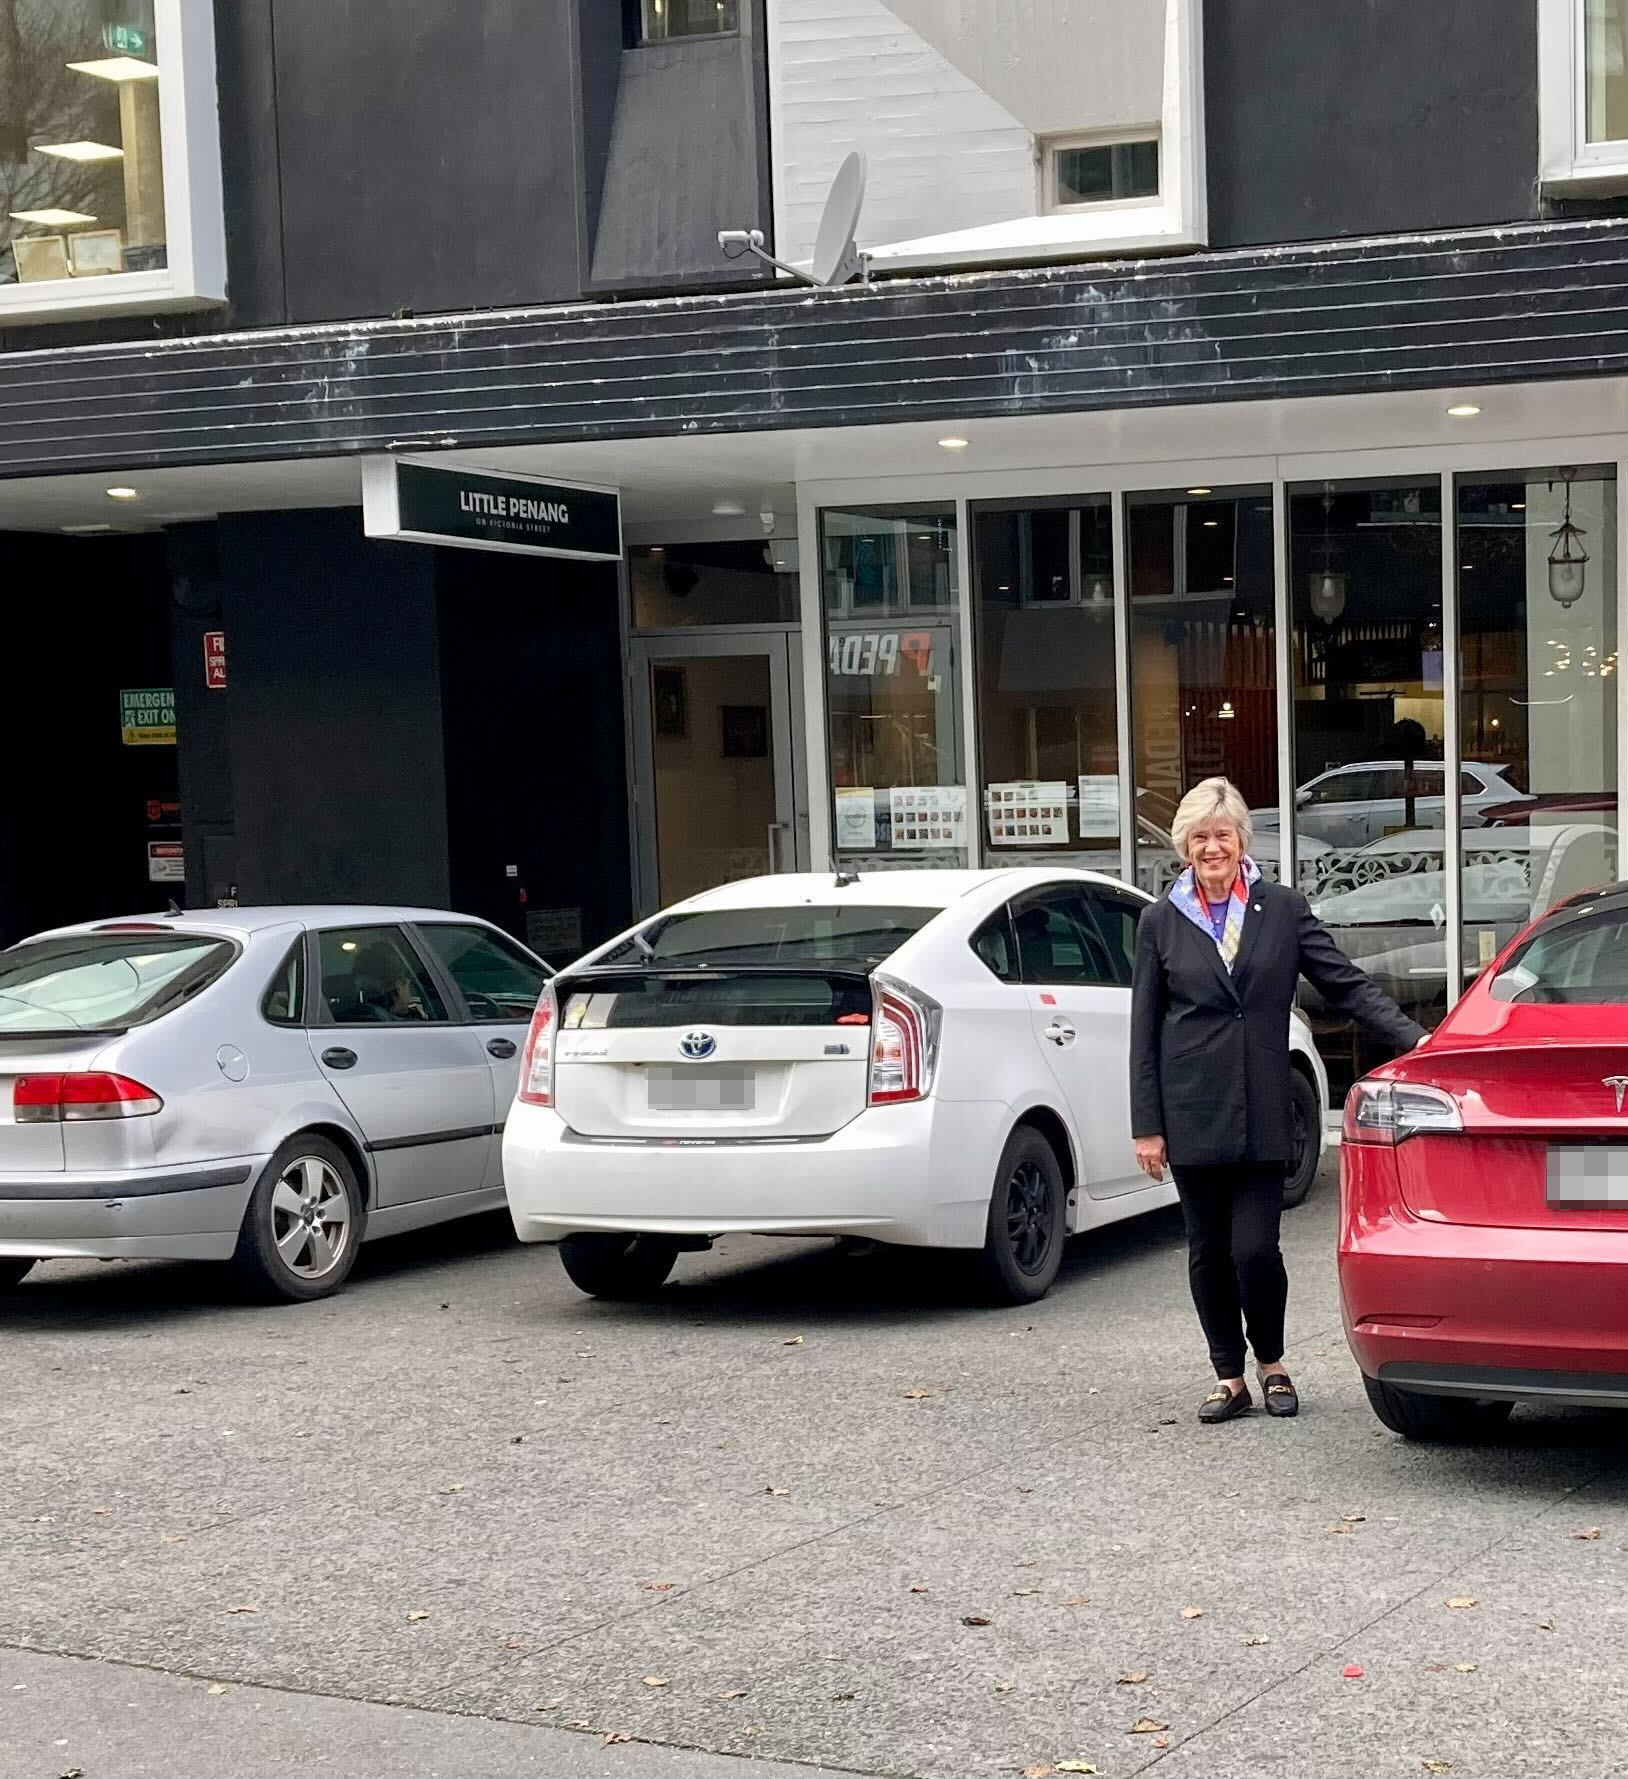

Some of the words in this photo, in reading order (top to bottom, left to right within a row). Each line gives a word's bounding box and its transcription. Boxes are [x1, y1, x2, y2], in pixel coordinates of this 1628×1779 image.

[461, 490, 506, 516] LITTLE
[510, 498, 569, 524] PENANG
[476, 517, 487, 526] ON
[489, 519, 524, 531] VICTORIA
[137, 709, 159, 725] EXIT
